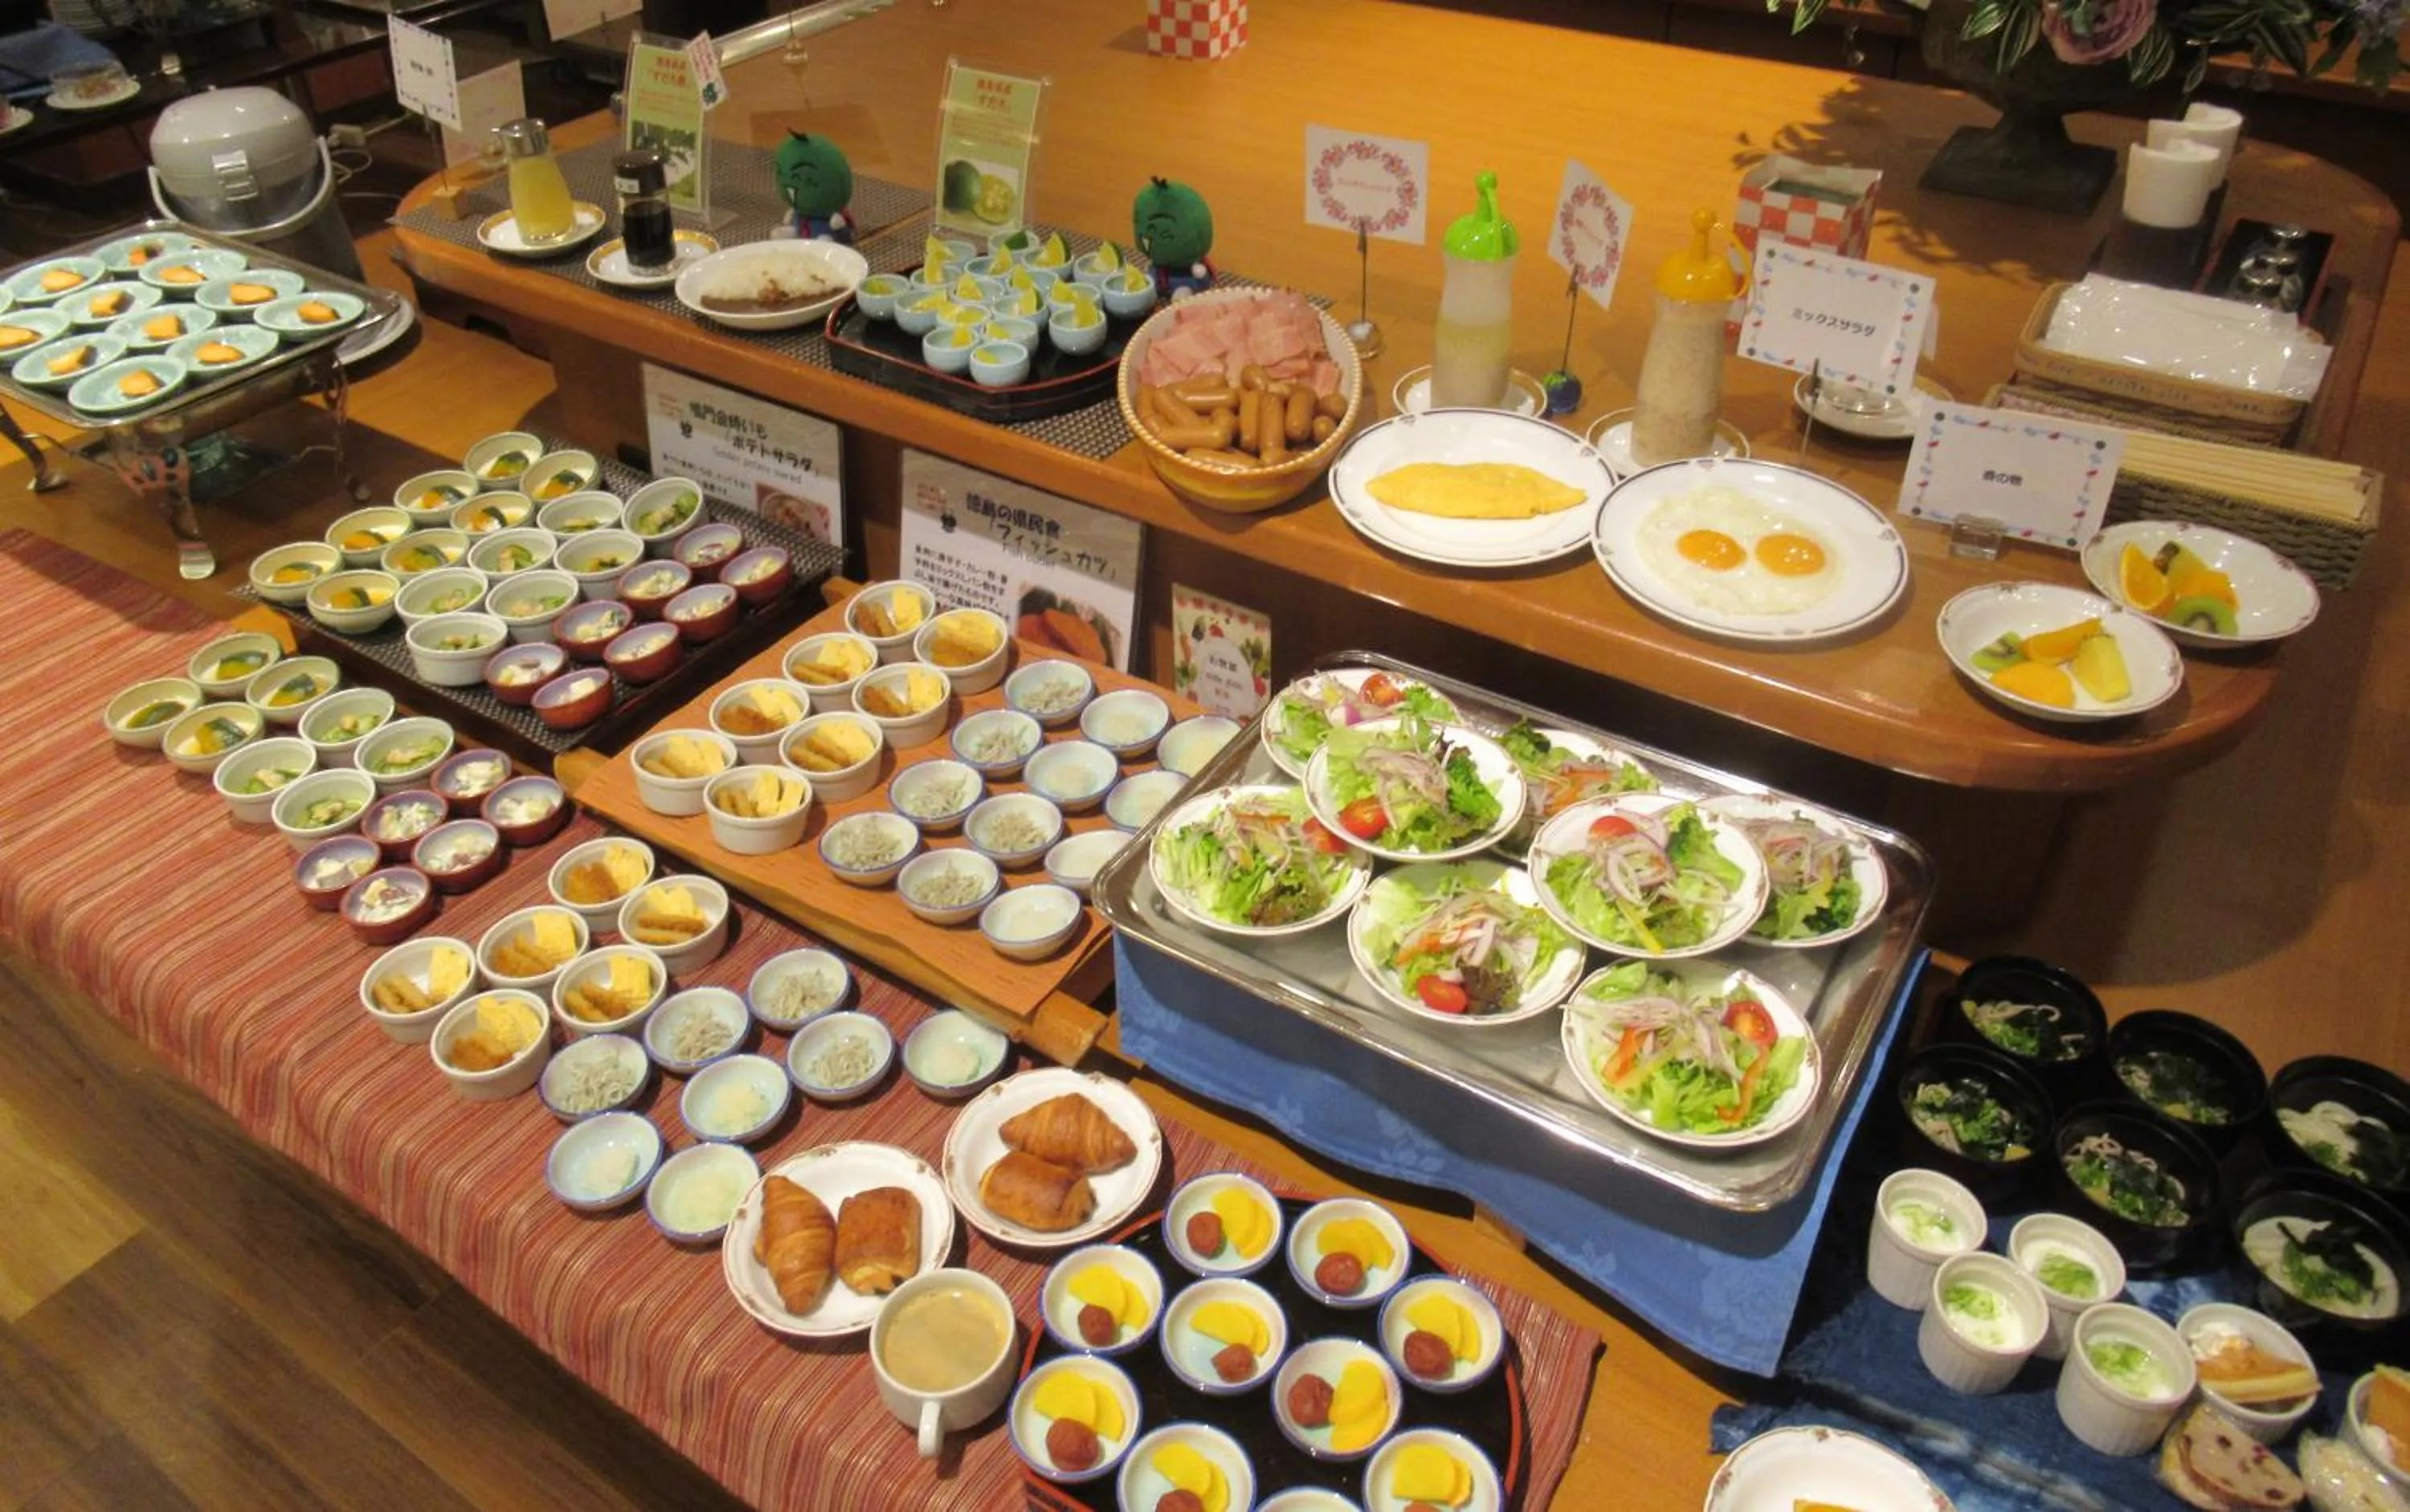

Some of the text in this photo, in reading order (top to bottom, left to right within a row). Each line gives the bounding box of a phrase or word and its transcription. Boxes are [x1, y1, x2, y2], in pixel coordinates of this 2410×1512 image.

[1791, 307, 1877, 337] ミックスサラダ
